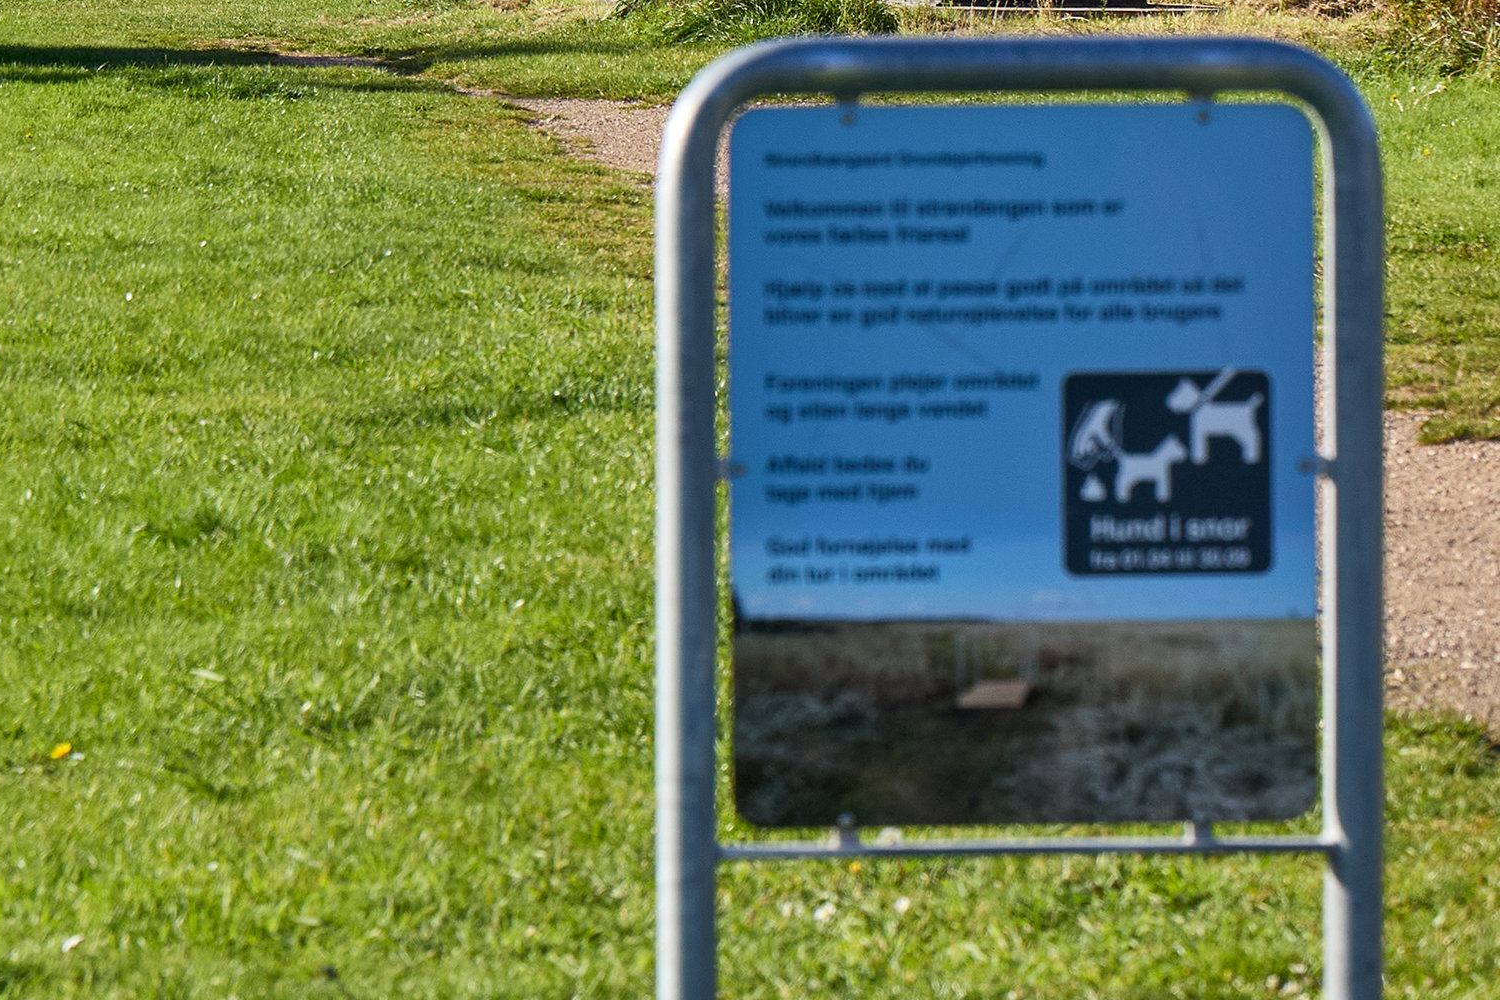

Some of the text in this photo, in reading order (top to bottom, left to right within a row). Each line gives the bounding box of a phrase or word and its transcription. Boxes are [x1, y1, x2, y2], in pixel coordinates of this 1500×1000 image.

[763, 196, 1124, 222] Velkommen til strandengen som er
[763, 226, 822, 246] vores
[827, 224, 890, 245] fælles
[831, 279, 856, 299] os
[862, 278, 908, 299] med
[938, 281, 999, 301] passe
[1089, 276, 1175, 295] området
[764, 303, 822, 327] bliver
[828, 306, 853, 325] en
[859, 304, 901, 330] god
[1098, 302, 1134, 322] alle
[1140, 302, 1224, 327] brugere
[764, 372, 882, 396] Foreningen
[953, 370, 1040, 391] området
[764, 402, 793, 426] og
[765, 454, 929, 476] Affald bedes du
[765, 482, 810, 507] tage
[817, 482, 862, 502] med
[1089, 515, 1166, 542] Hund
[1185, 517, 1249, 541] snor
[766, 533, 973, 557] God fornøjelse med
[1090, 551, 1116, 568] fra
[1176, 550, 1194, 566] til
[766, 563, 800, 585] din
[805, 564, 834, 584] tur
[853, 563, 942, 583] området
